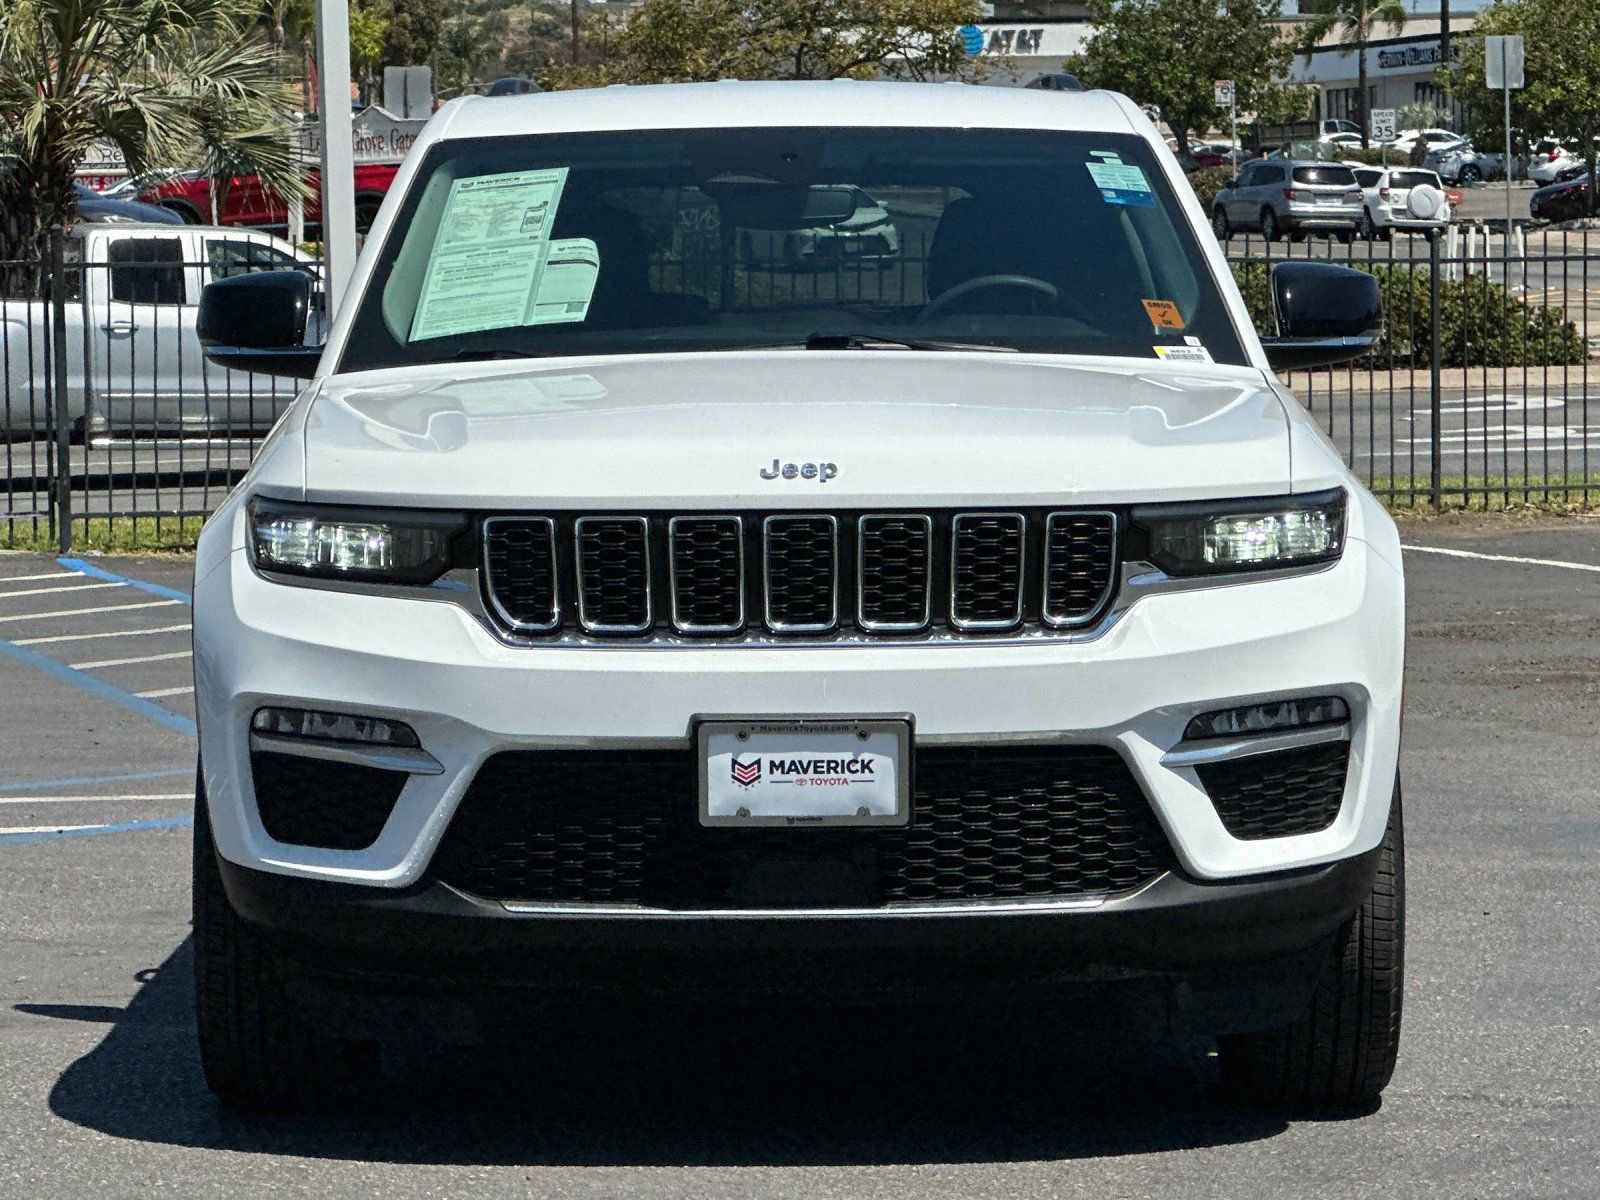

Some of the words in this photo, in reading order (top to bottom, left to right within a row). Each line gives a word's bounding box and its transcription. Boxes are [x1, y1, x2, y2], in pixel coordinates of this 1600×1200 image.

[987, 29, 1045, 54] AT&T
[352, 129, 385, 151] Grove
[1374, 126, 1394, 138] 35
[477, 177, 520, 185] MAVERICK
[760, 459, 838, 483] Jeep
[760, 725, 849, 733] MaverickToyota.com
[769, 759, 874, 775] MAVERICK
